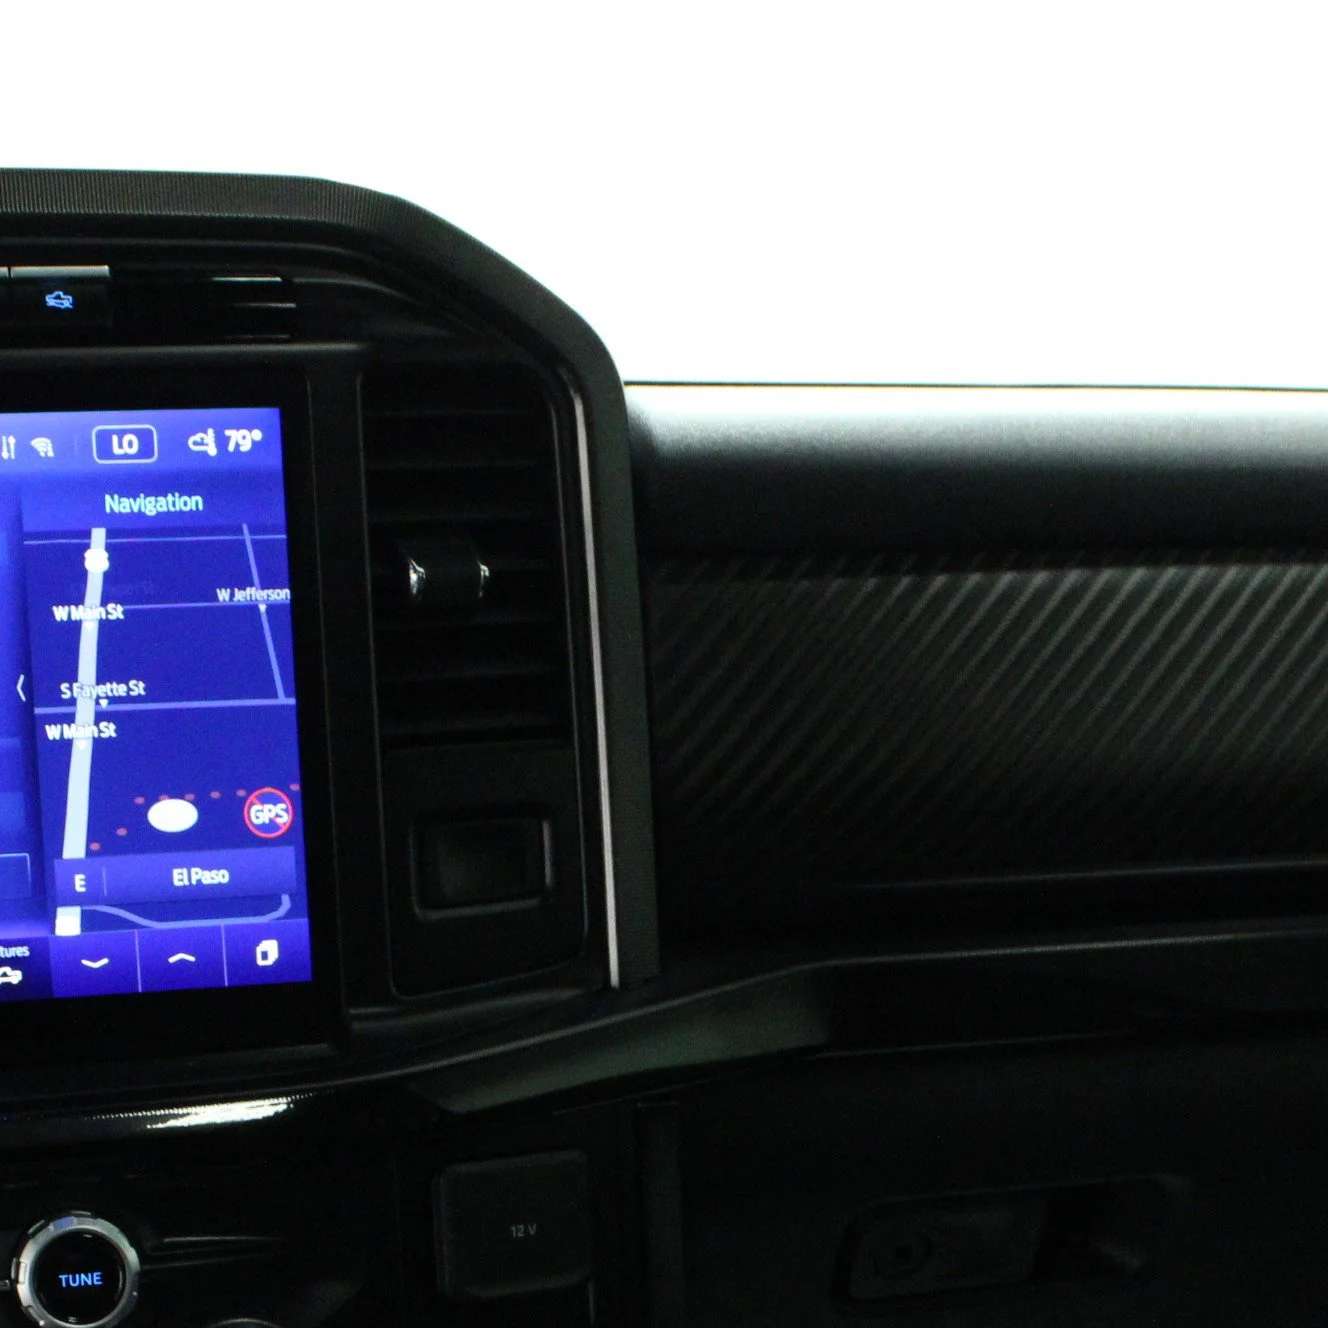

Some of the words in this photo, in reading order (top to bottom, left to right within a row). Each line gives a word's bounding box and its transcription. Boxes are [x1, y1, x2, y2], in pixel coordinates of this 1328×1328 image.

[111, 434, 139, 455] LO
[225, 428, 263, 452] 79°
[104, 492, 203, 516] Navigation
[217, 588, 231, 602] W
[233, 585, 291, 601] Jefferson
[53, 606, 69, 622] W
[70, 605, 106, 622] Main
[107, 604, 124, 620] St
[60, 683, 71, 698] S
[73, 681, 126, 701] Fayette
[128, 681, 146, 696] St
[45, 724, 63, 741] W
[64, 723, 99, 740] Main
[100, 722, 117, 738] St
[250, 803, 289, 824] GPS
[75, 875, 86, 892] E
[173, 869, 186, 886] El
[188, 868, 229, 885] Paso
[59, 1272, 103, 1288] TUNE
